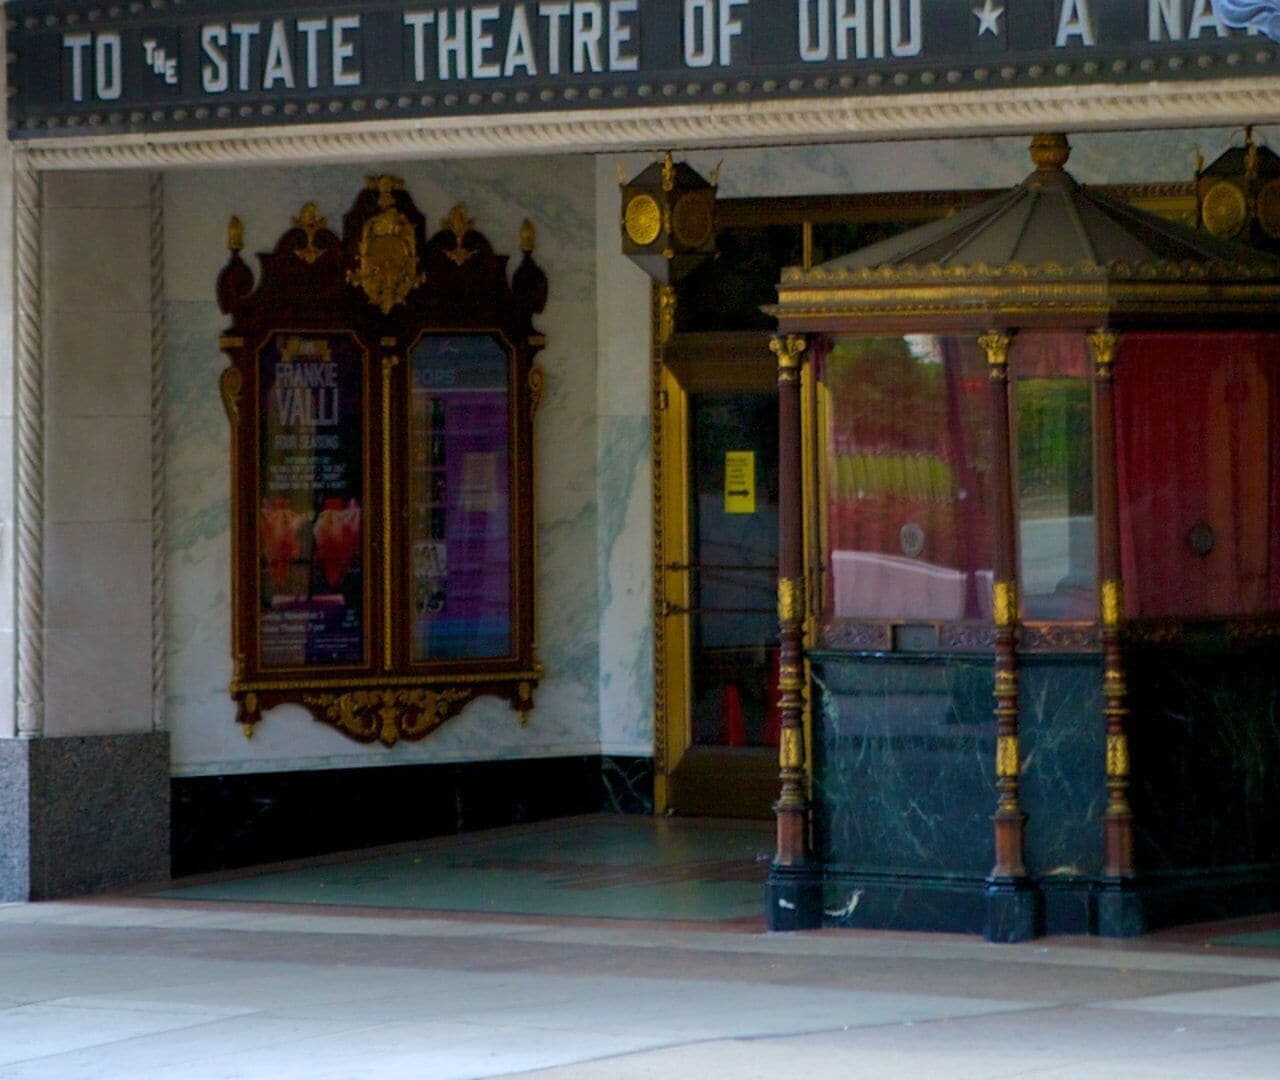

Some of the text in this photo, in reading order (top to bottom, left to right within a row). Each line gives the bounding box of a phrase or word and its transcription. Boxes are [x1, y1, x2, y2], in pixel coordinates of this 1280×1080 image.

[62, 33, 122, 103] TO
[143, 38, 178, 86] THE
[200, 14, 362, 94] STATE
[274, 387, 339, 426] VALLI
